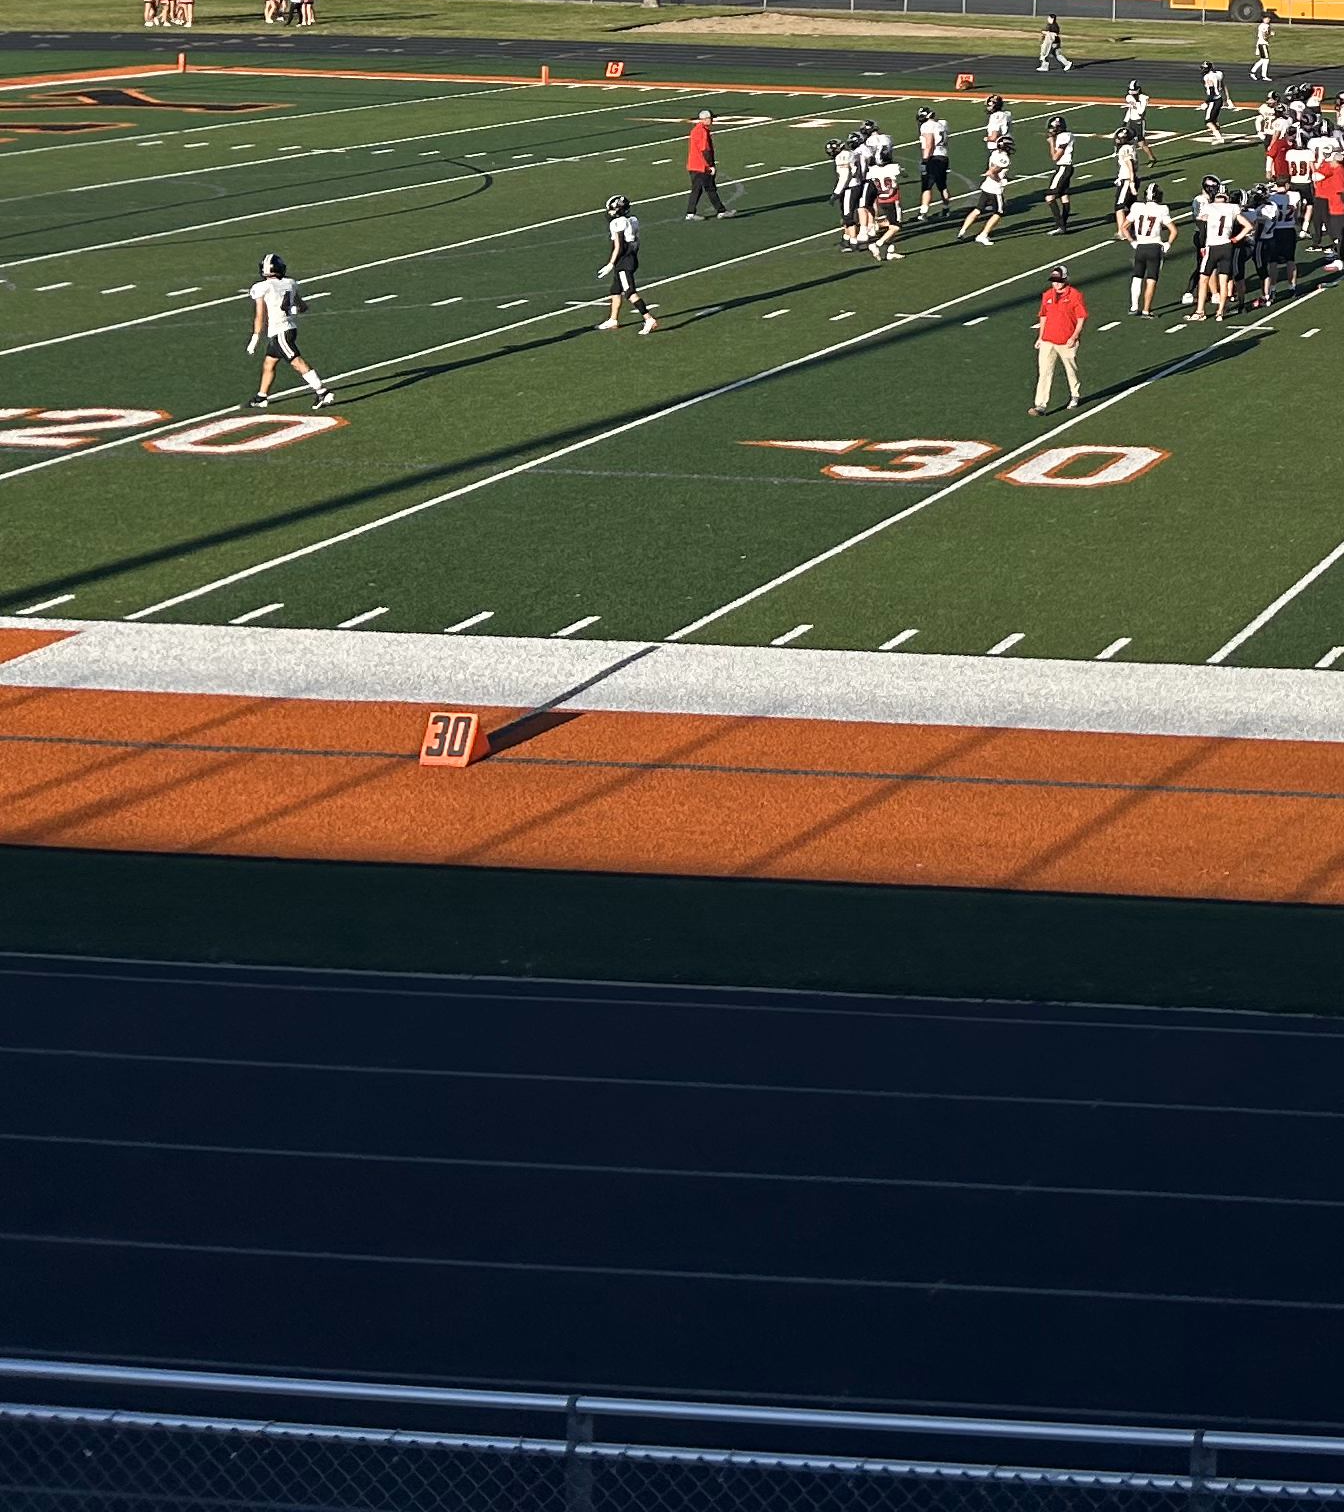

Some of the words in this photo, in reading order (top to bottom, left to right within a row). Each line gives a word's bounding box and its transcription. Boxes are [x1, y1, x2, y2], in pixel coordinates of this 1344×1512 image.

[1137, 214, 1157, 237] 17
[1218, 215, 1227, 237] 1
[820, 438, 1172, 488] 30
[425, 714, 472, 757] 30
